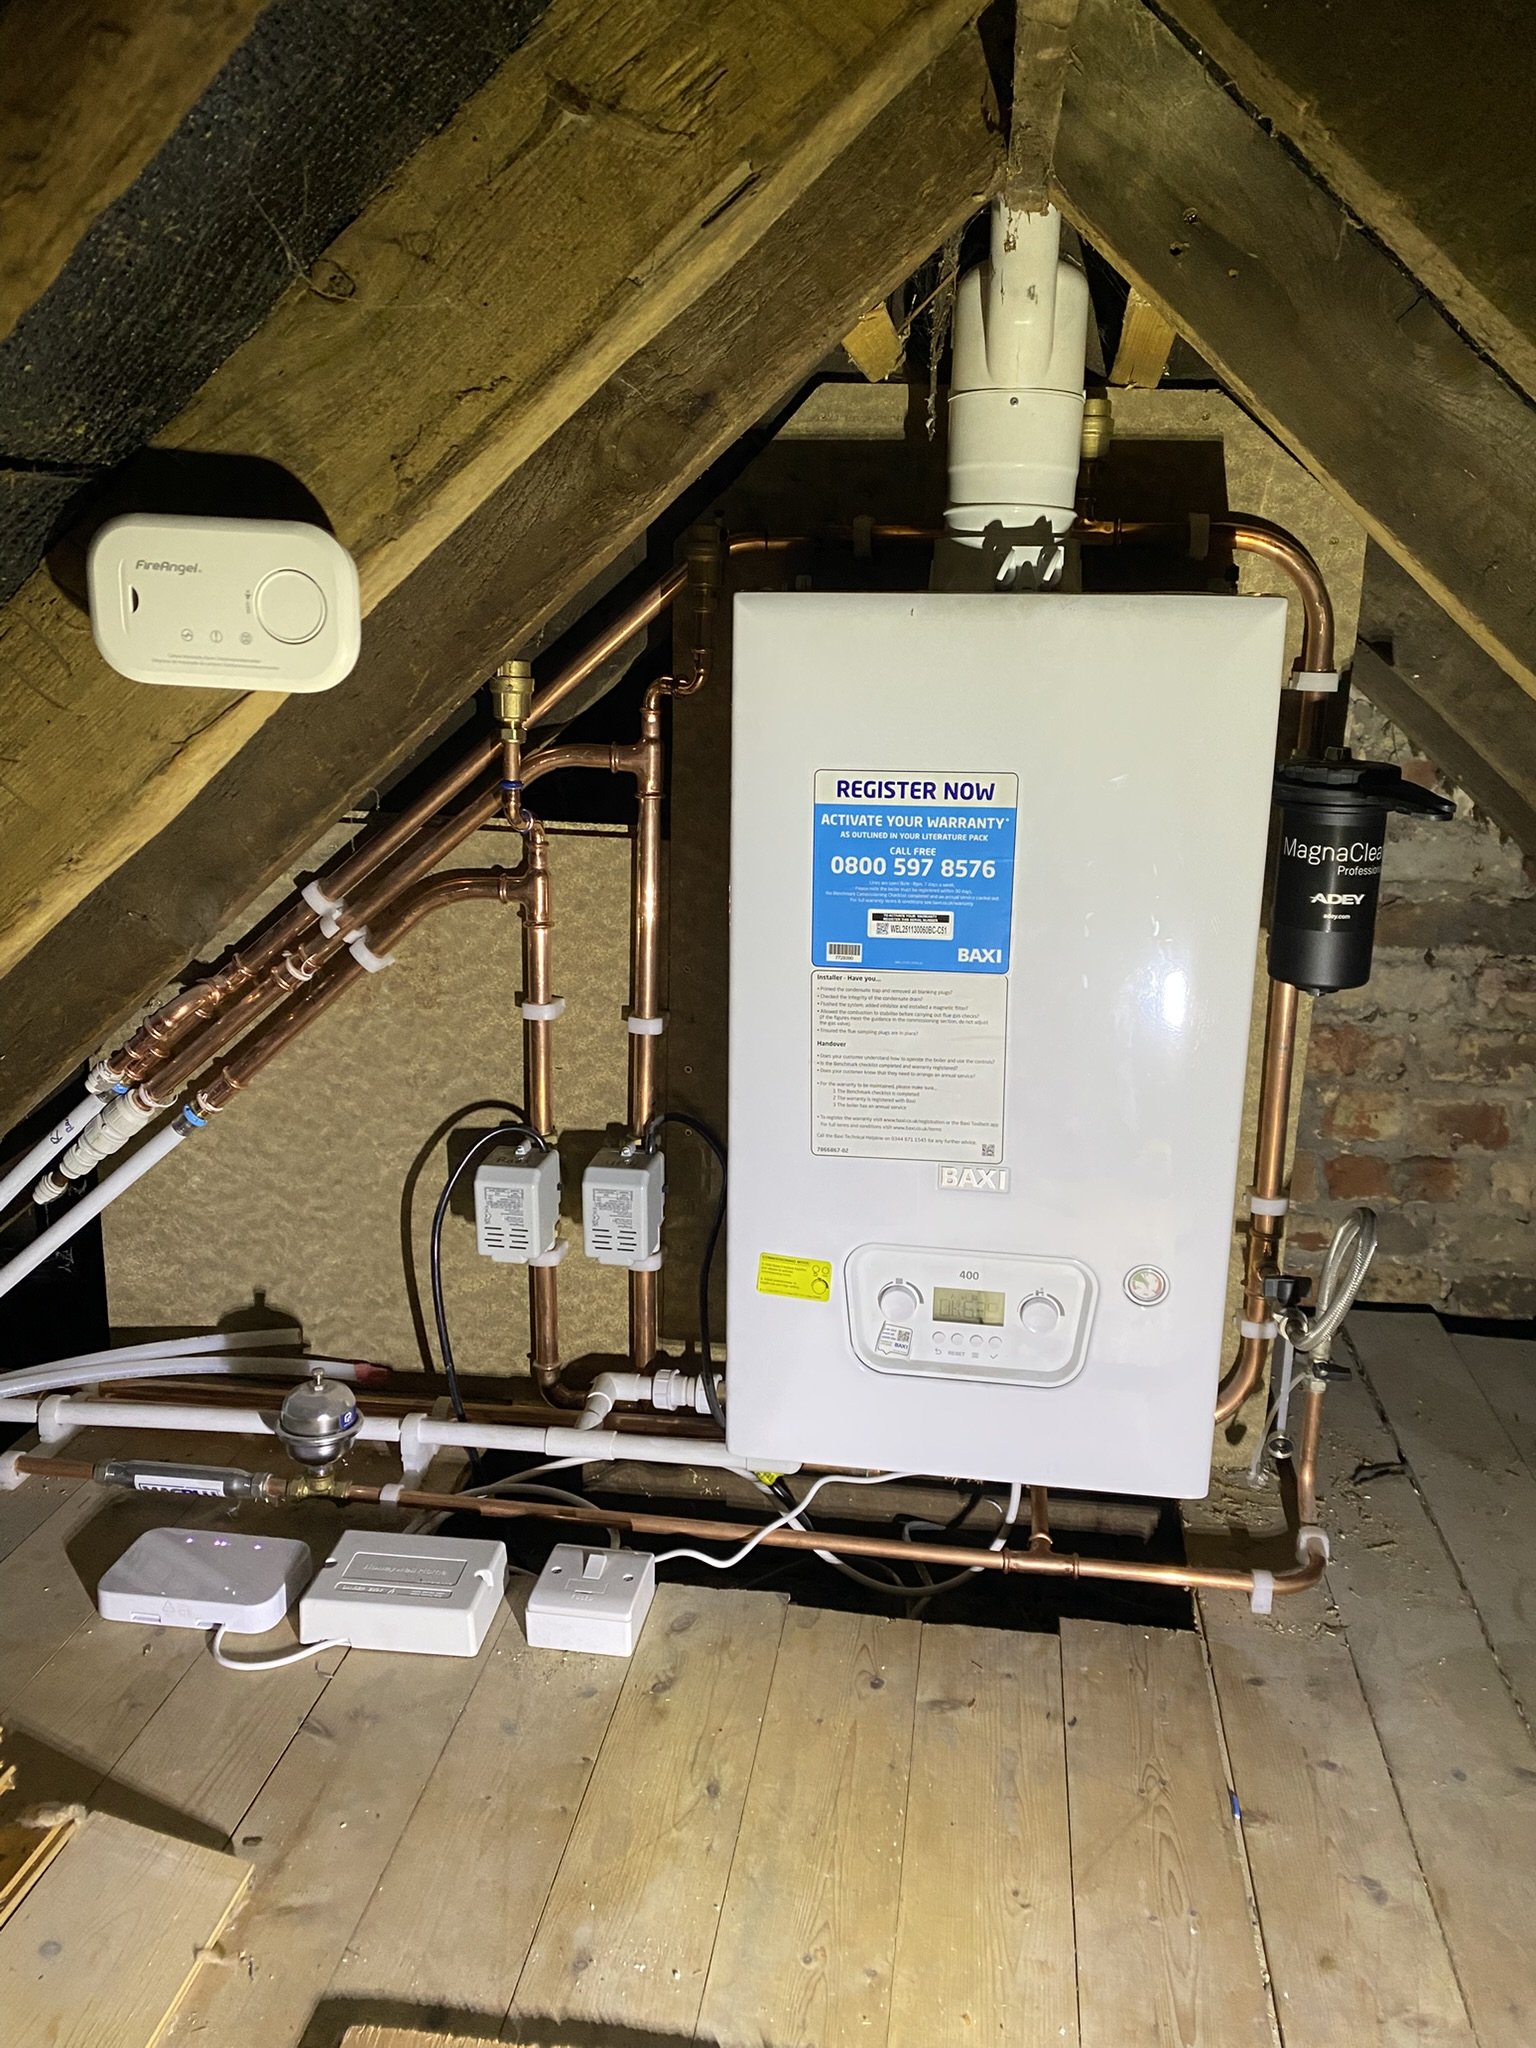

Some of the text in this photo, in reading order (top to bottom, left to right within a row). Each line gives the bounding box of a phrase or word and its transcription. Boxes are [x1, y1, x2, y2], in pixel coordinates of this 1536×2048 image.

[135, 559, 199, 576] FireAngel
[836, 779, 996, 801] REGISTER NOW
[821, 813, 883, 826] ACTIVATE
[886, 815, 923, 828] YOUR
[840, 830, 850, 838] AS
[851, 831, 888, 839] OUTLINED
[900, 832, 920, 840] YOUR
[921, 833, 967, 841] LITERATURE
[968, 834, 989, 842] PACK
[889, 846, 937, 856] CALL FREE
[1283, 836, 1383, 865] MagnaClea
[830, 855, 996, 878] 0800 597 8576
[1310, 893, 1365, 905] ADEY
[958, 947, 1002, 964] BAXI
[941, 1165, 1006, 1190] BAXI
[959, 1270, 980, 1281] 400
[894, 1342, 908, 1350] BAXI
